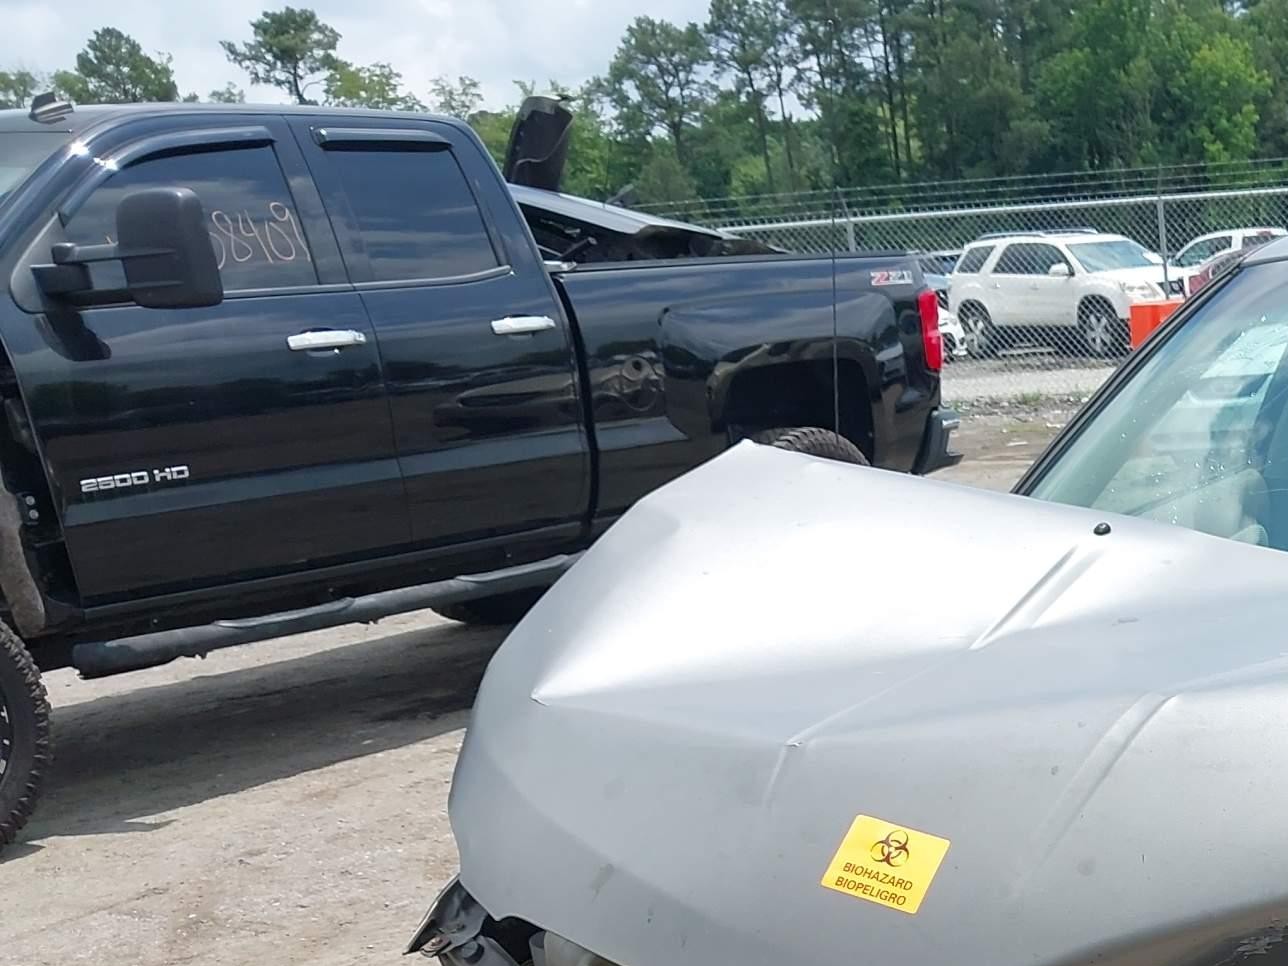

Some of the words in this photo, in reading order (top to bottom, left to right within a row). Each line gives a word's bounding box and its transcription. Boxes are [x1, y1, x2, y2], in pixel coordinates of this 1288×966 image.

[80, 471, 150, 493] 2500
[153, 465, 190, 482] HD
[843, 862, 913, 890] BIOHAZARD
[835, 876, 907, 906] BIOPELIGRO
